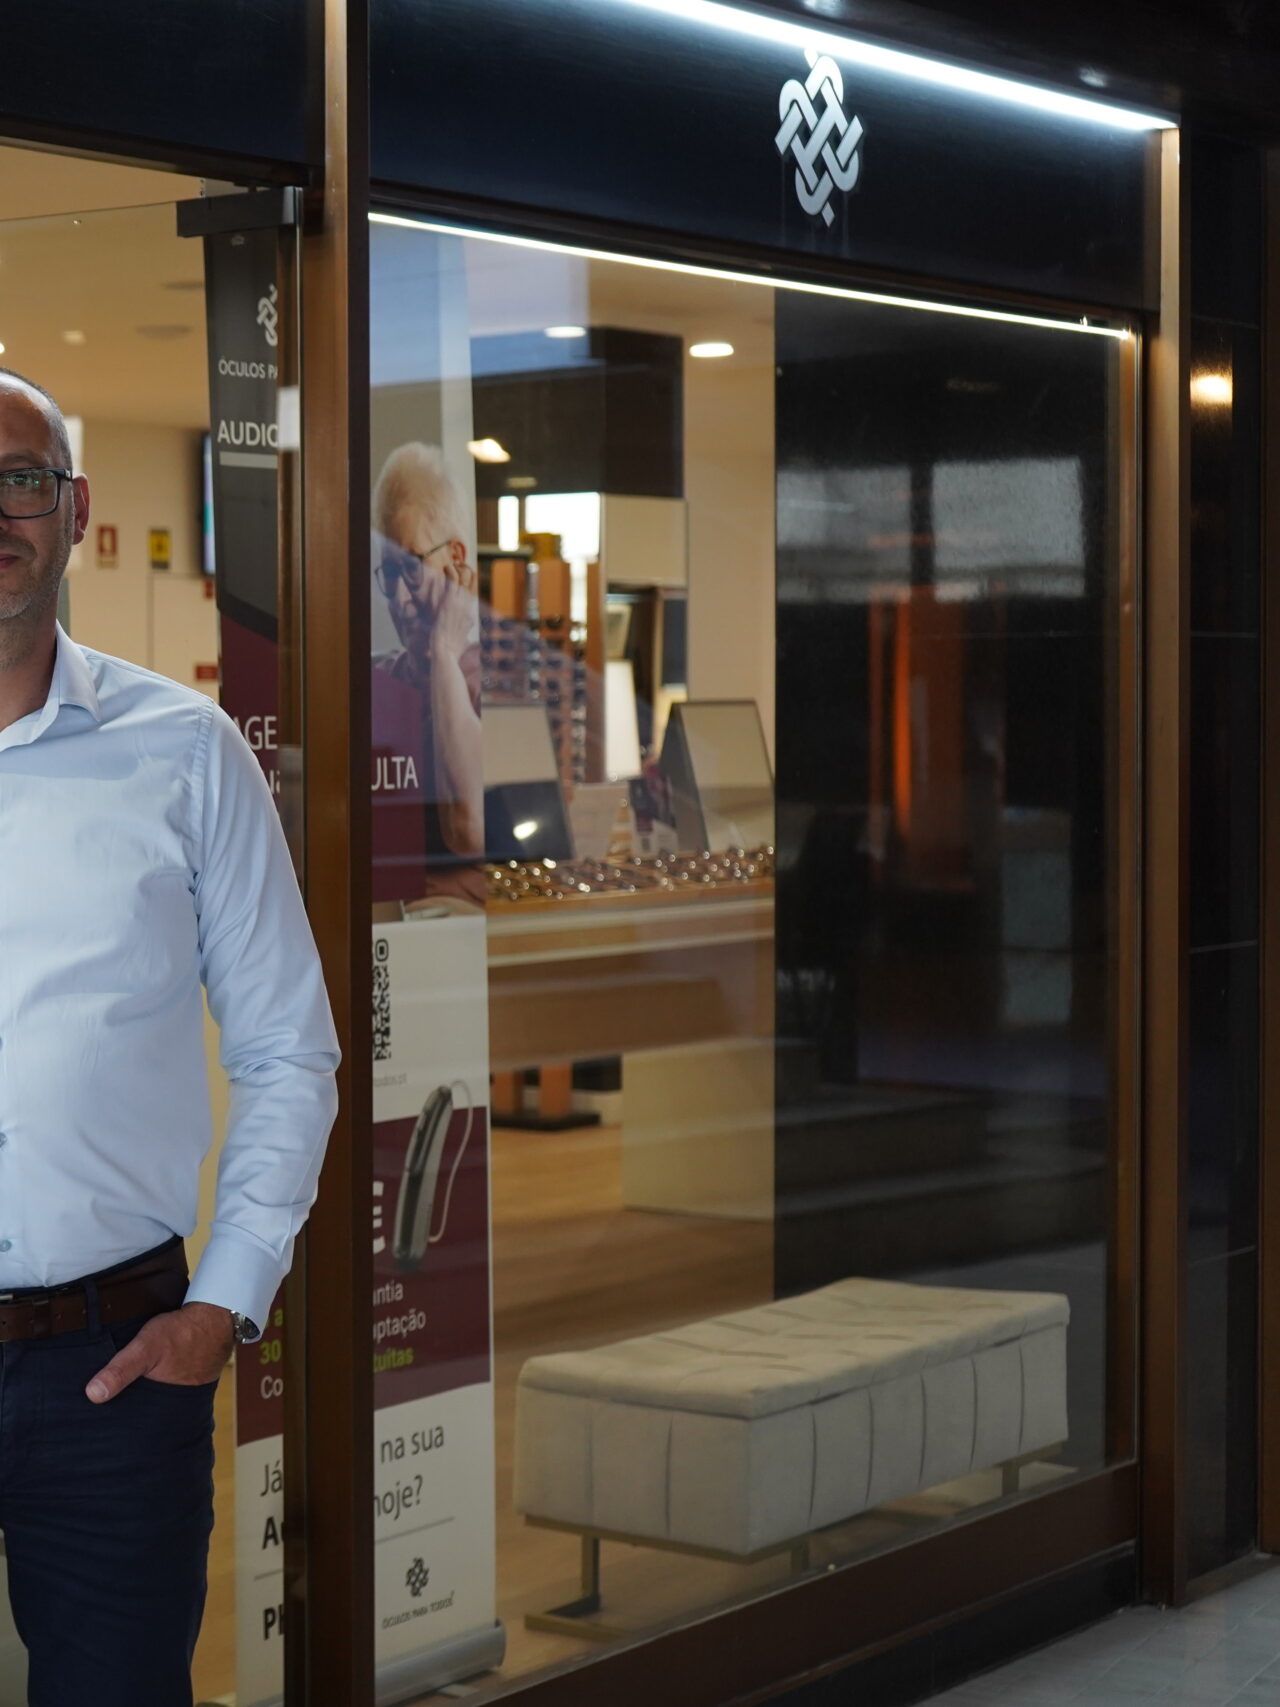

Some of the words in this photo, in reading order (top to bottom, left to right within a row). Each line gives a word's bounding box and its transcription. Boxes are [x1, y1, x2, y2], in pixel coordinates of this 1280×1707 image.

[218, 356, 266, 379] ÓCULOS
[380, 1436, 405, 1465] na
[412, 1425, 445, 1456] sua
[260, 1459, 283, 1498] Já
[262, 1516, 284, 1550] A
